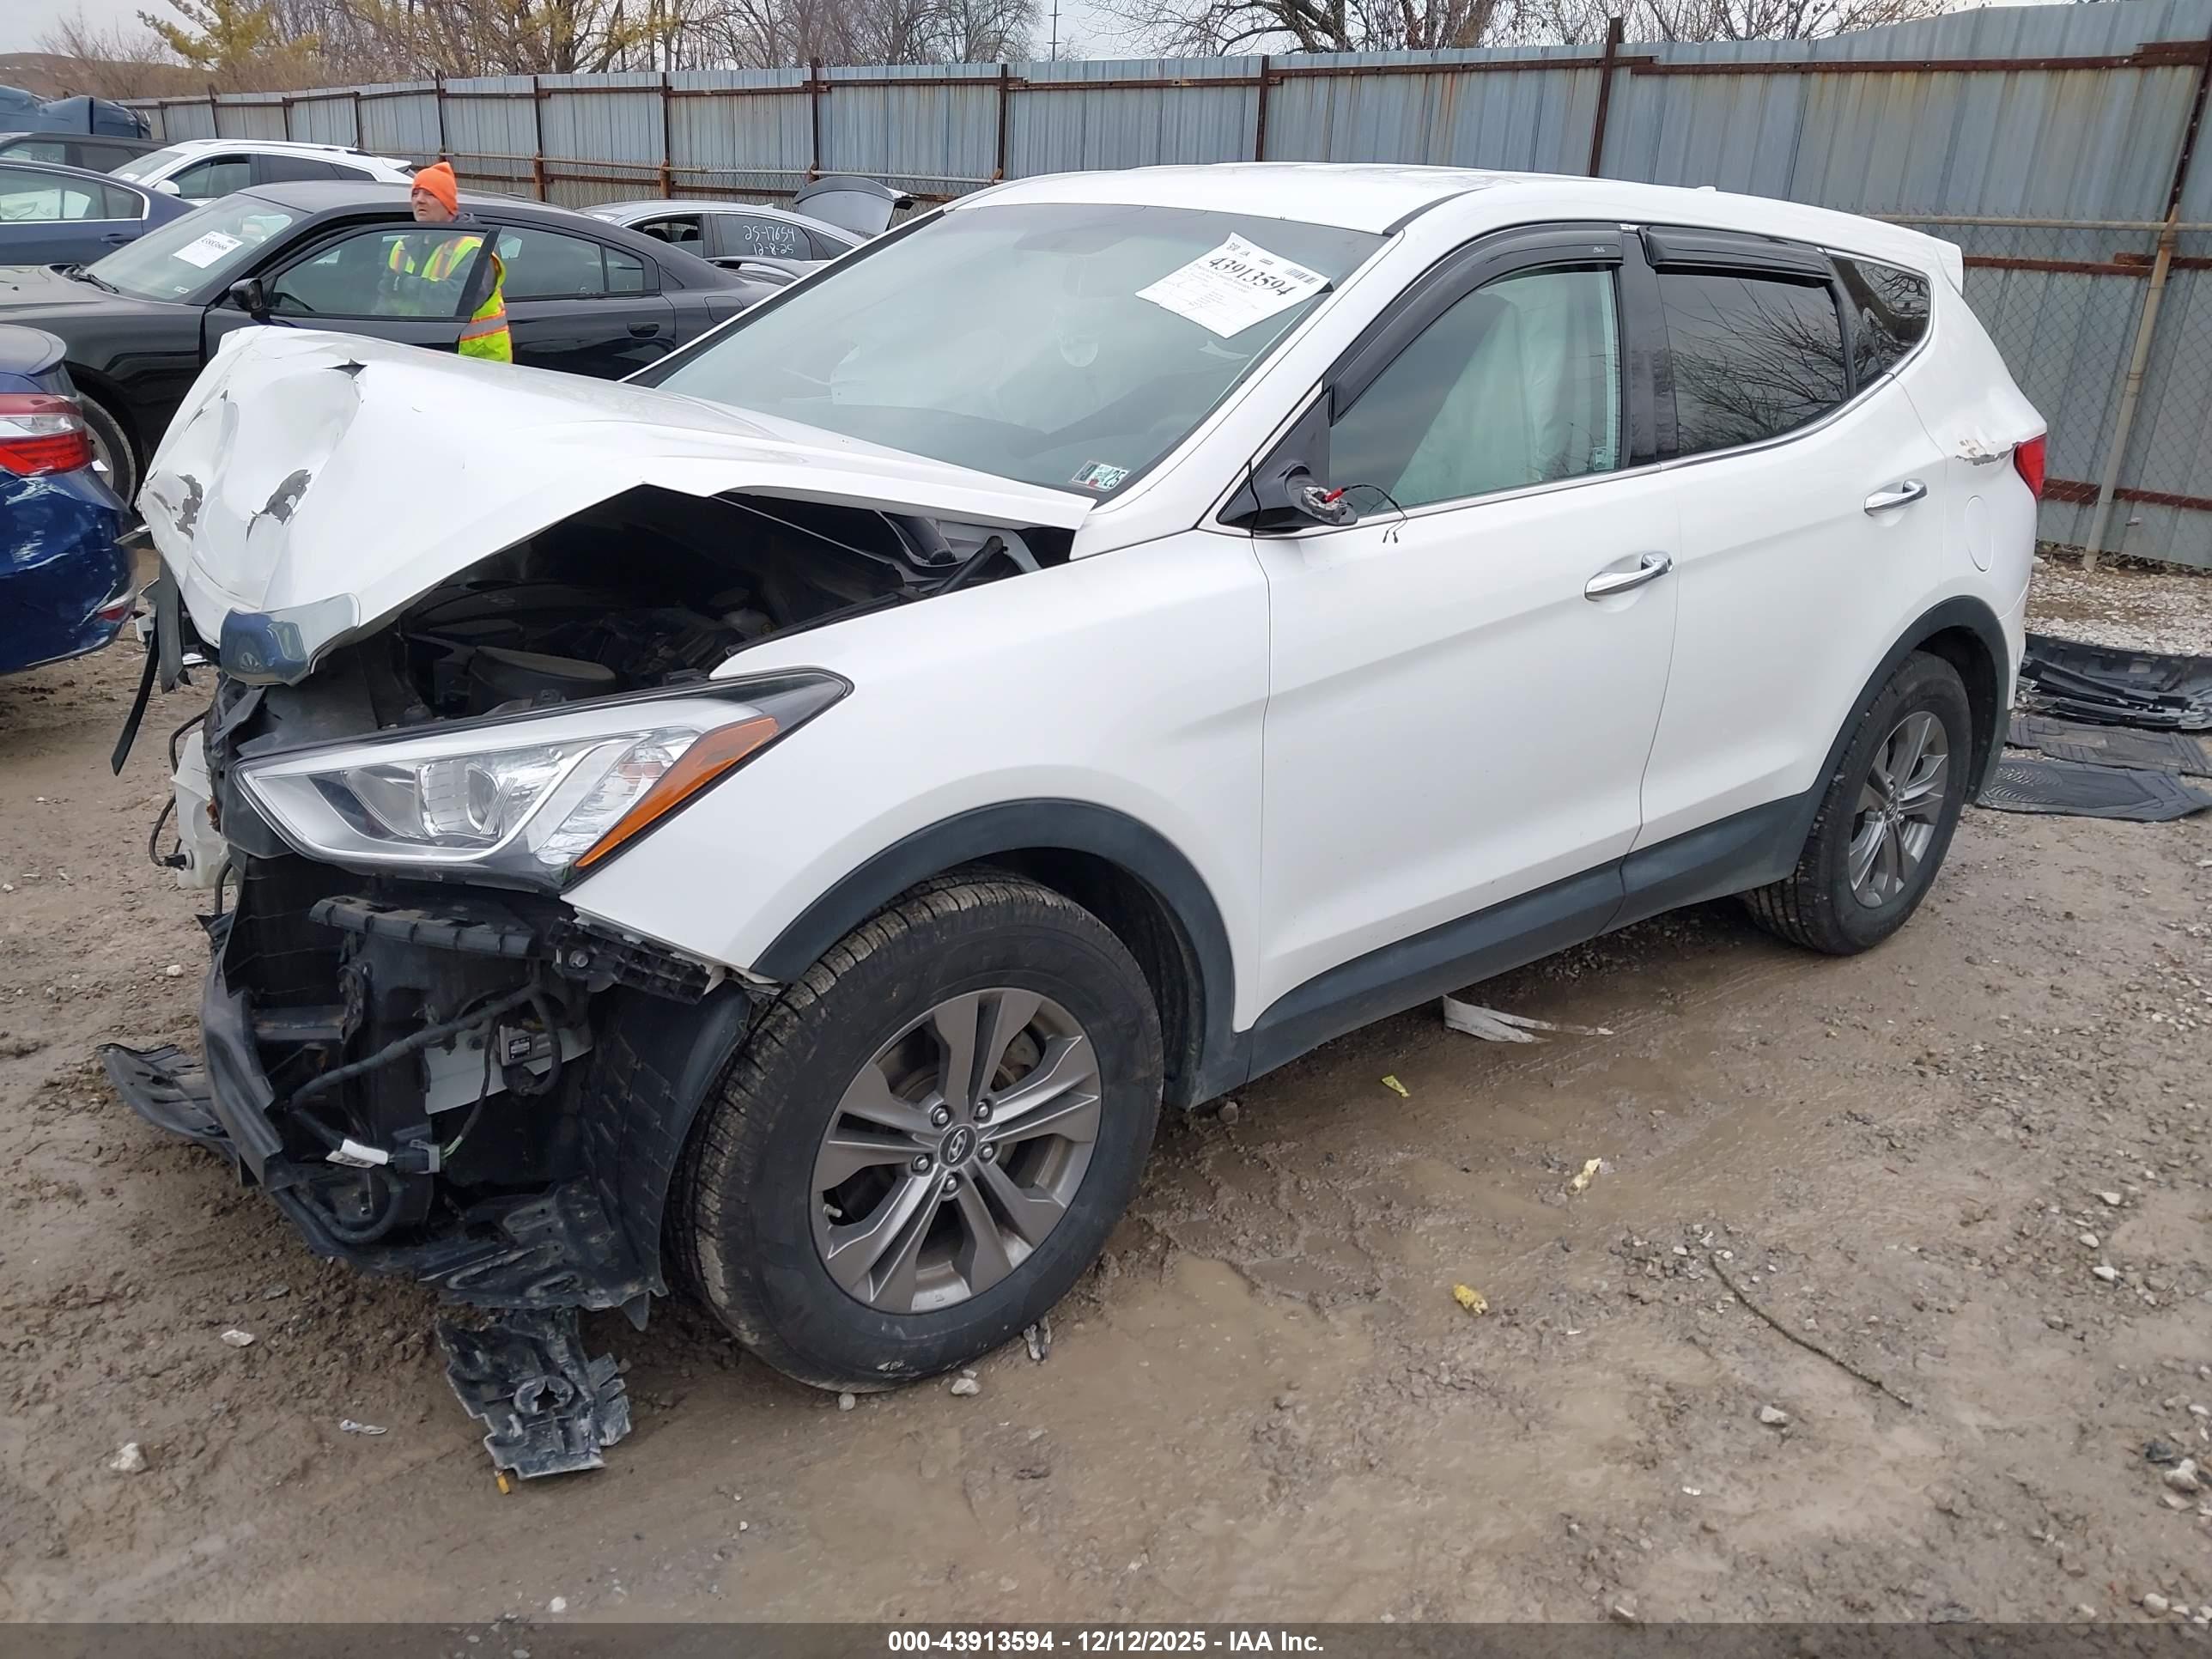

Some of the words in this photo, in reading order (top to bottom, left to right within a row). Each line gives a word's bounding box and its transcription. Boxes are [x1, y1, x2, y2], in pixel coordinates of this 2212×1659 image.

[753, 243, 794, 256] 12-8-25
[1208, 257, 1297, 296] 43913594
[1103, 470, 1127, 488] 25
